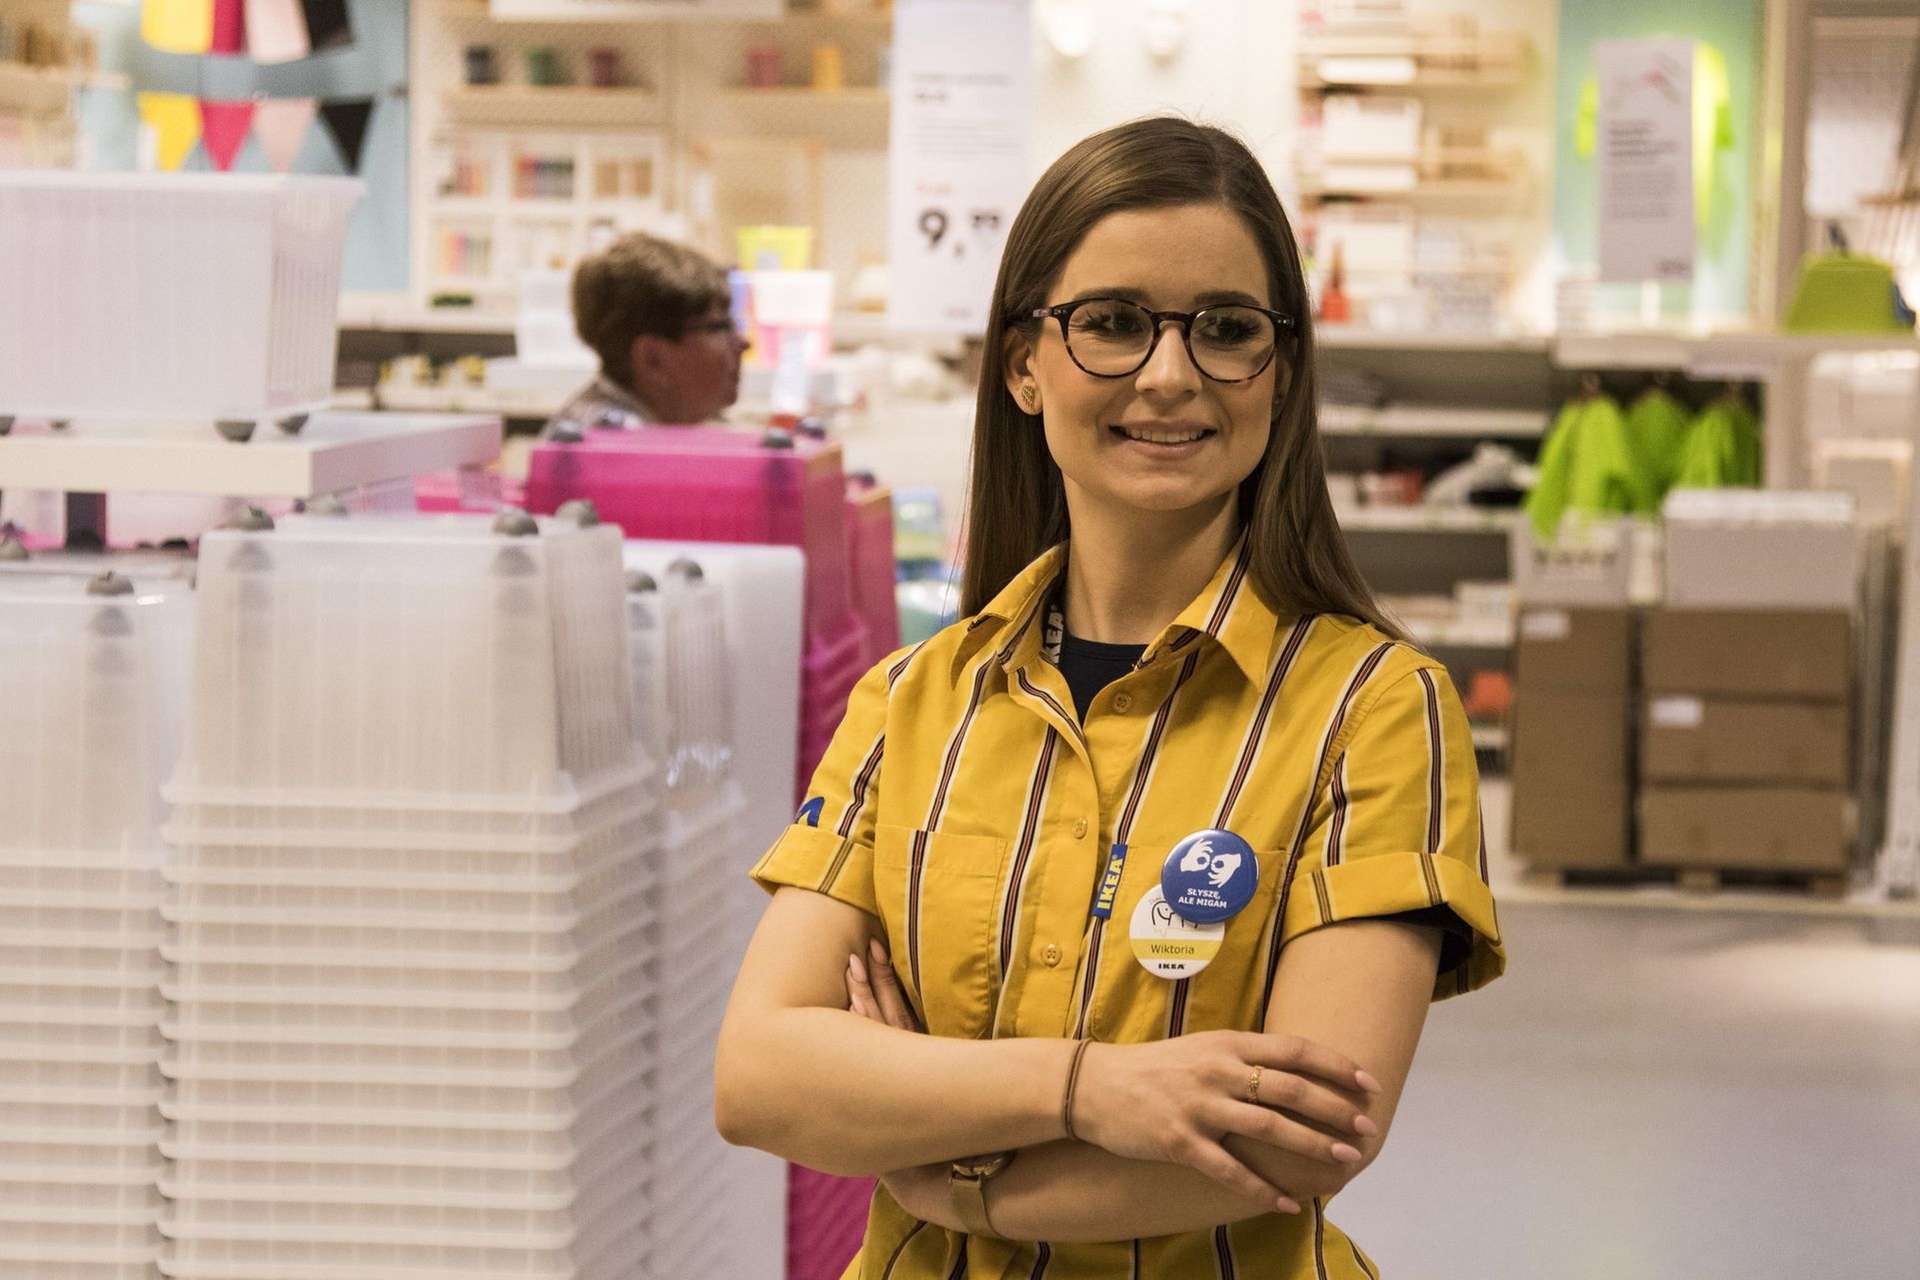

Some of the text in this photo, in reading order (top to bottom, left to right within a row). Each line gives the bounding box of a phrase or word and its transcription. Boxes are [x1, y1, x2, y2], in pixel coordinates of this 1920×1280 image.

[1045, 611, 1064, 664] KEA
[1097, 858, 1123, 910] IKEA
[1178, 896, 1227, 908] ALE MIGAM
[1151, 944, 1195, 954] Wiktoria
